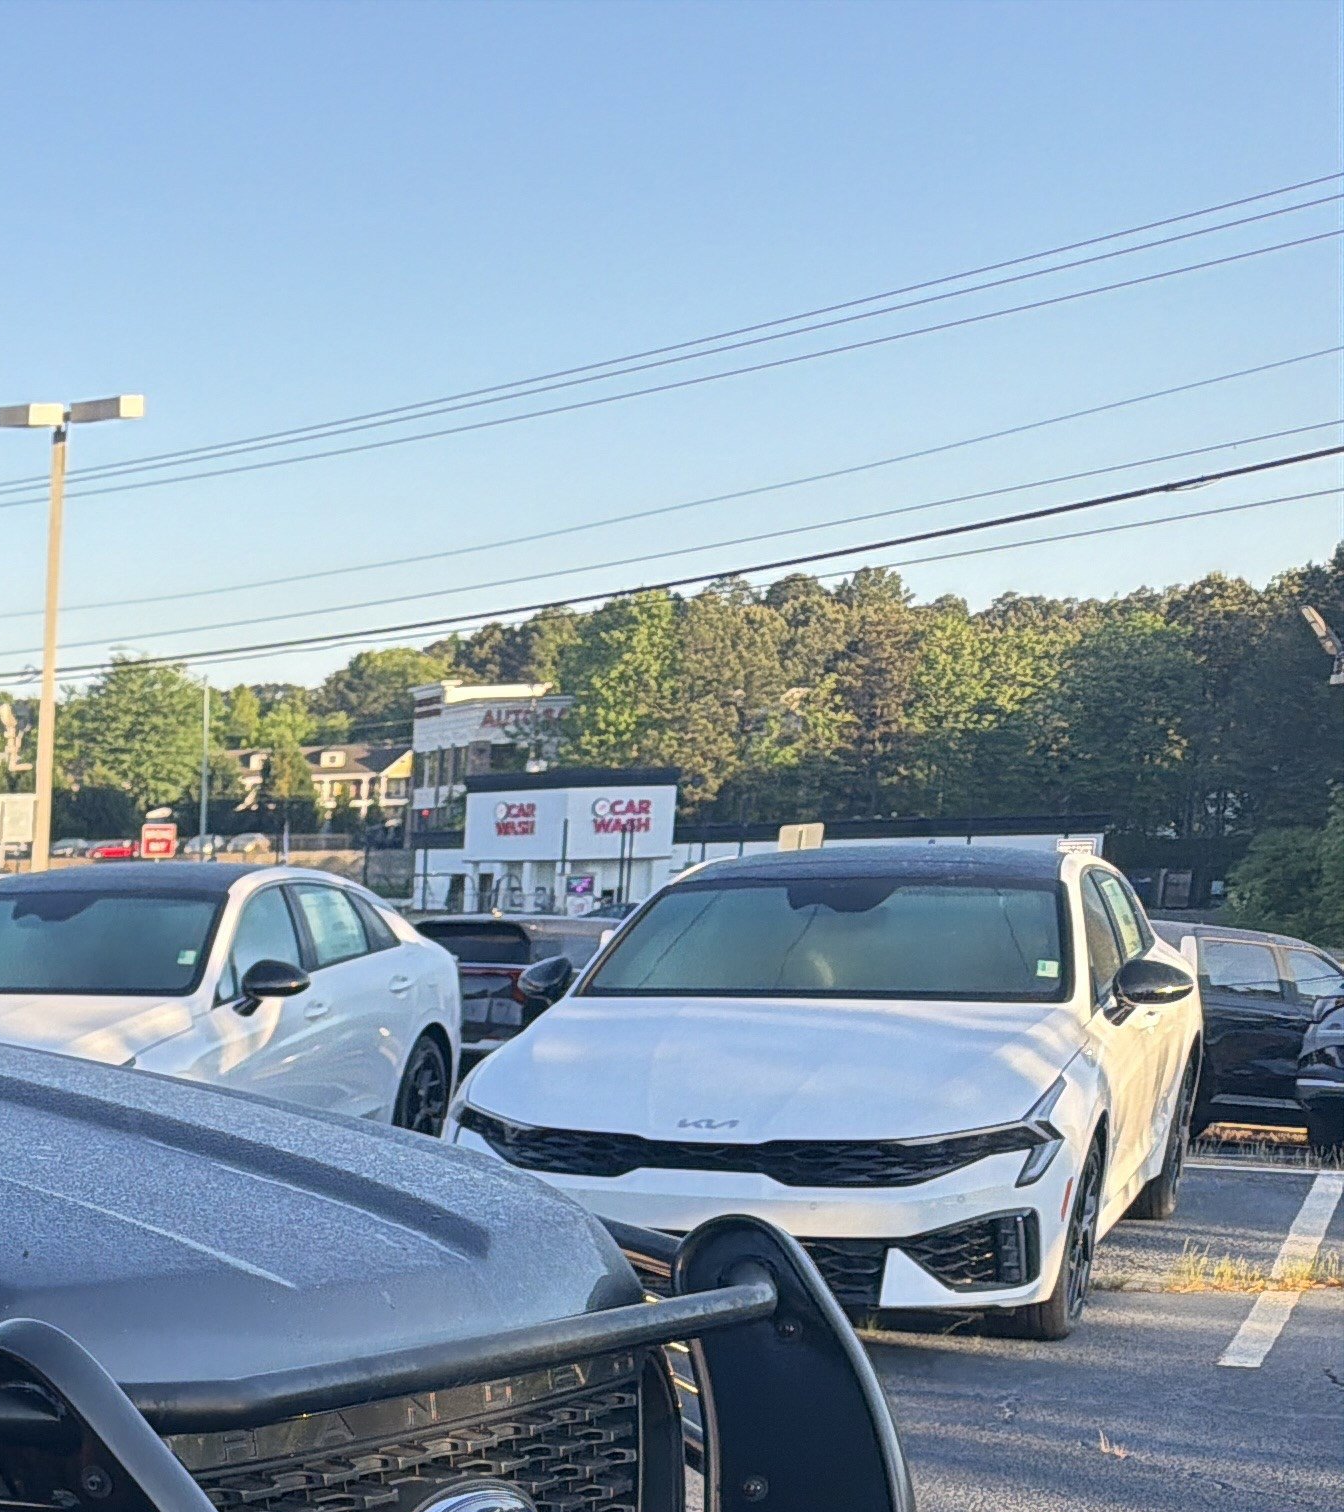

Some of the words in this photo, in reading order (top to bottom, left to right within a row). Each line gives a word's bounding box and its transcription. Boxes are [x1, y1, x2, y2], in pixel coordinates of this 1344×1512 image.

[507, 803, 537, 818] CAR
[610, 799, 652, 816] CAR
[495, 819, 536, 836] WASH
[592, 816, 652, 834] WASH
